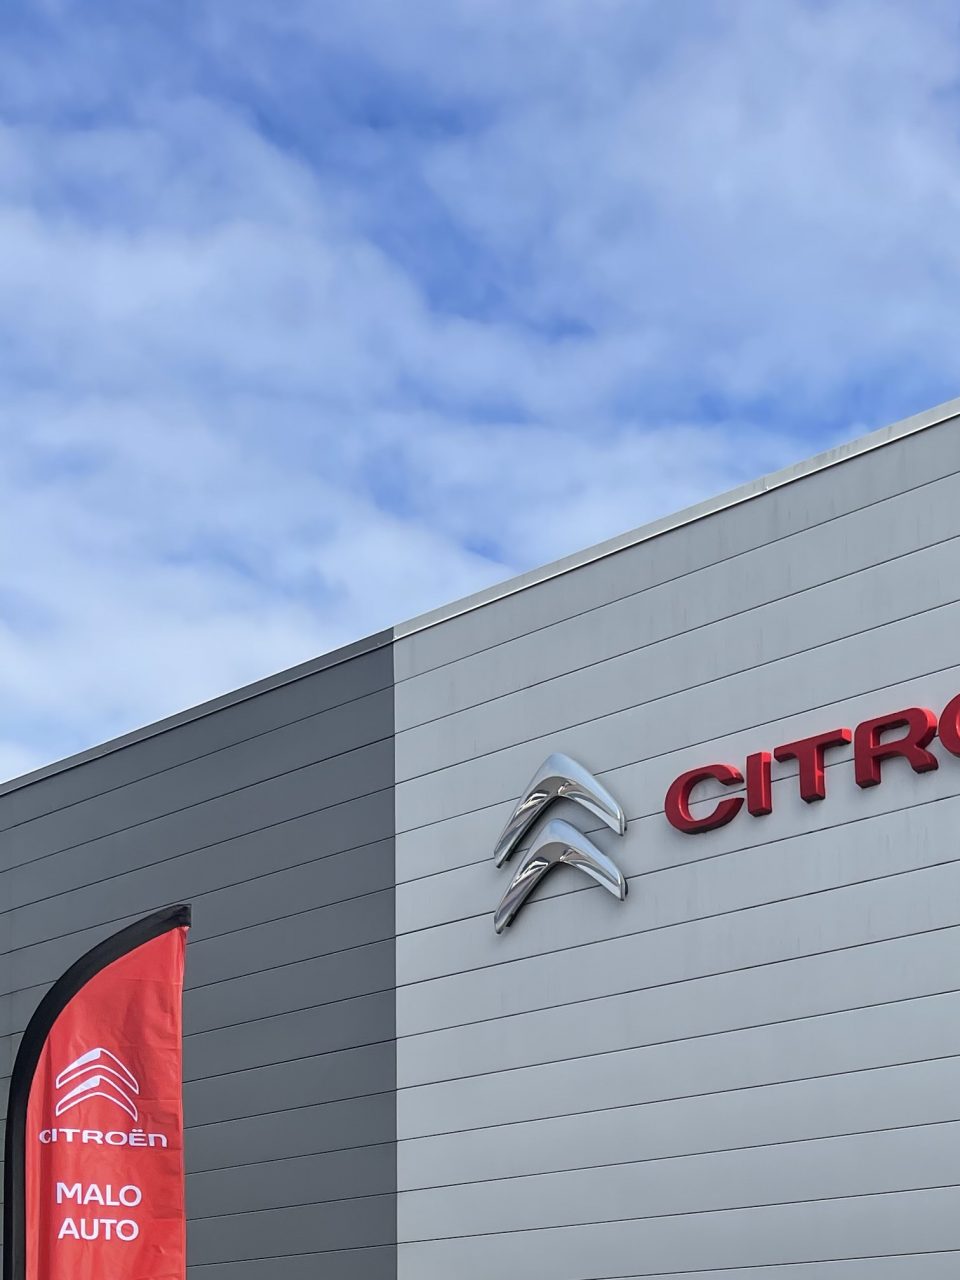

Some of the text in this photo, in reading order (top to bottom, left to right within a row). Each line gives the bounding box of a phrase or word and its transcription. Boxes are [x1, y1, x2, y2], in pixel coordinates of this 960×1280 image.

[38, 1127, 168, 1148] CITROËN
[56, 1181, 143, 1208] MALO
[57, 1216, 140, 1242] AUTO
